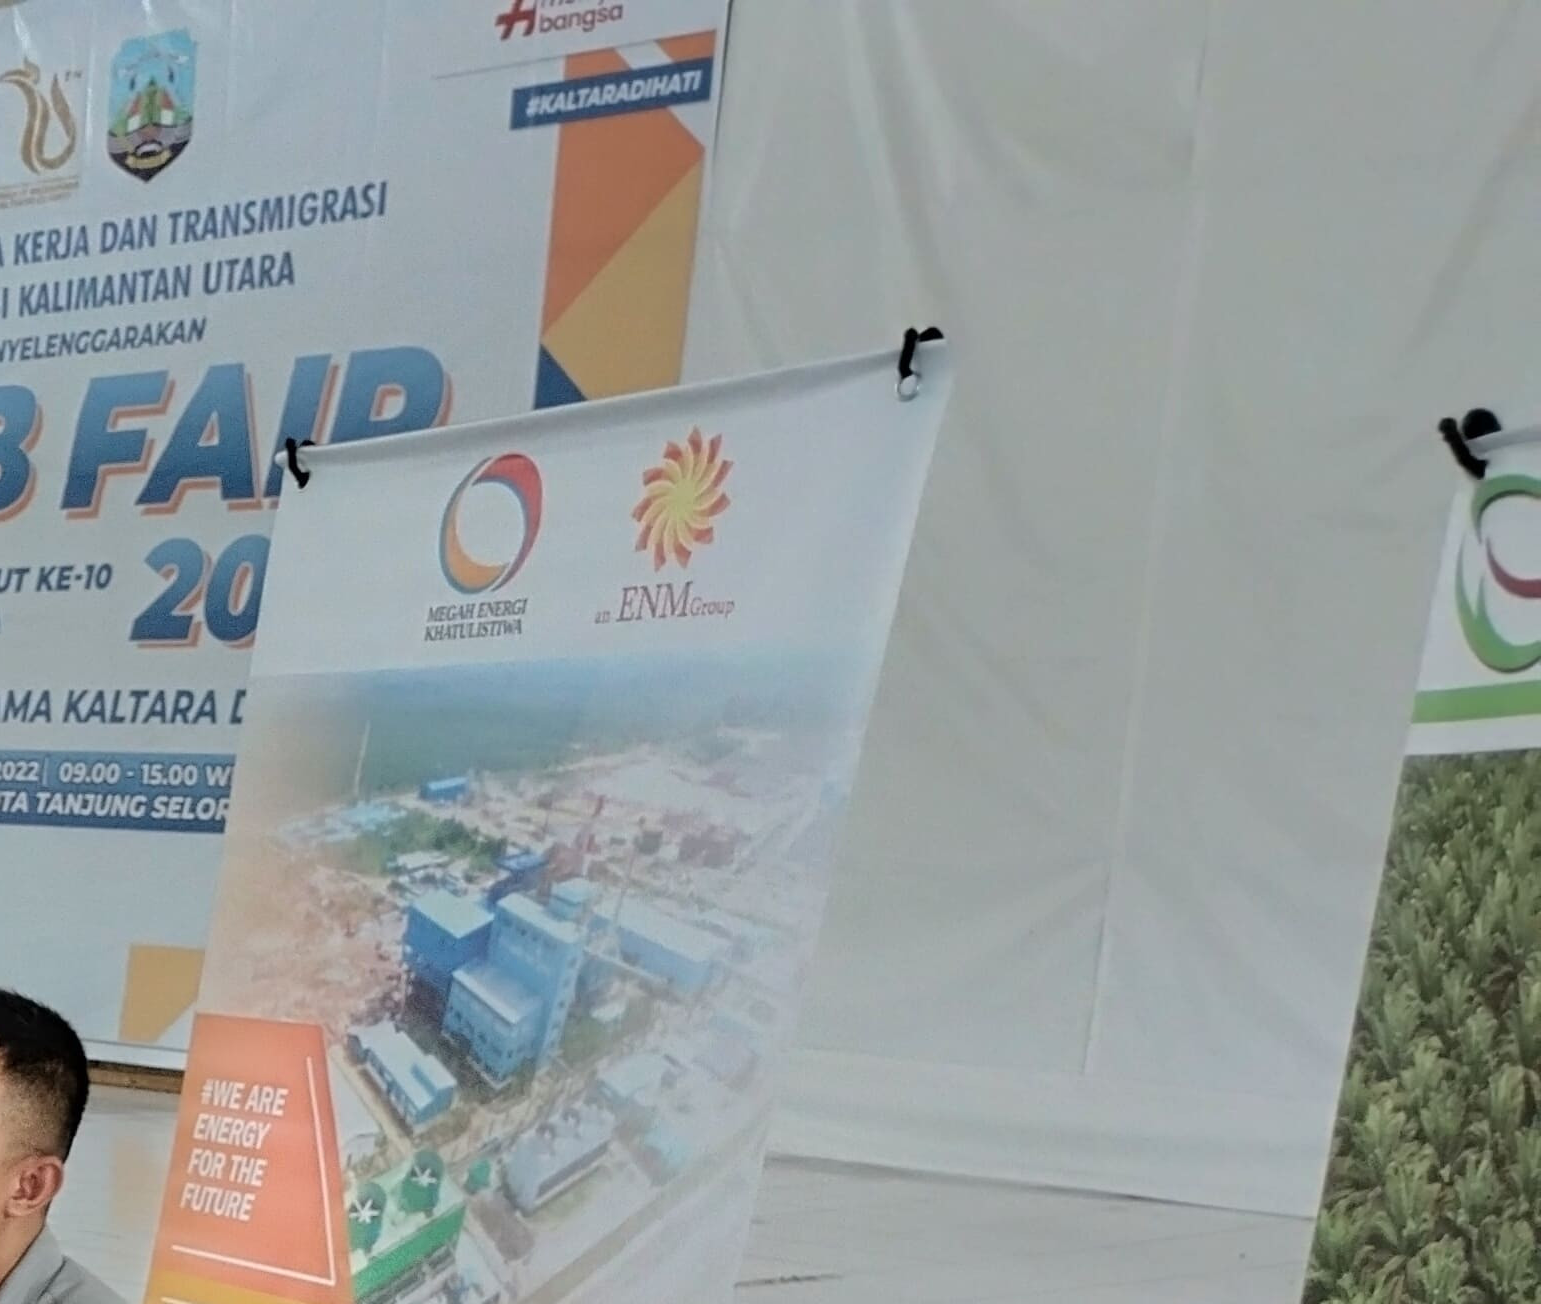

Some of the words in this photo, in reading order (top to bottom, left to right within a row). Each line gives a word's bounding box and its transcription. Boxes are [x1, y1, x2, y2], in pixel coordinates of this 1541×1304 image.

[539, 5, 623, 33] bangsa
[526, 70, 702, 117] #KALTARADIHATI
[13, 225, 89, 266] KERJA
[100, 214, 158, 254] DAN
[168, 180, 387, 246] TRANSMIGRASI
[19, 265, 190, 318] KALIMANTAN
[203, 252, 295, 295] UTARA
[37, 563, 113, 593] KE-10
[427, 601, 475, 623] MEGAH
[475, 598, 528, 620] ENERGI
[424, 618, 523, 641] KHATULISTIWA
[62, 689, 217, 725] KALTARA
[59, 762, 120, 784] 09.00
[140, 764, 198, 787] 15.00
[35, 791, 146, 818] TANJUNG
[201, 1078, 243, 1109] #WE
[245, 1084, 289, 1117] ARE
[192, 1113, 271, 1149] ENERGY
[187, 1149, 227, 1179] FOR
[228, 1154, 267, 1187] THE
[180, 1182, 255, 1222] FUTURE
